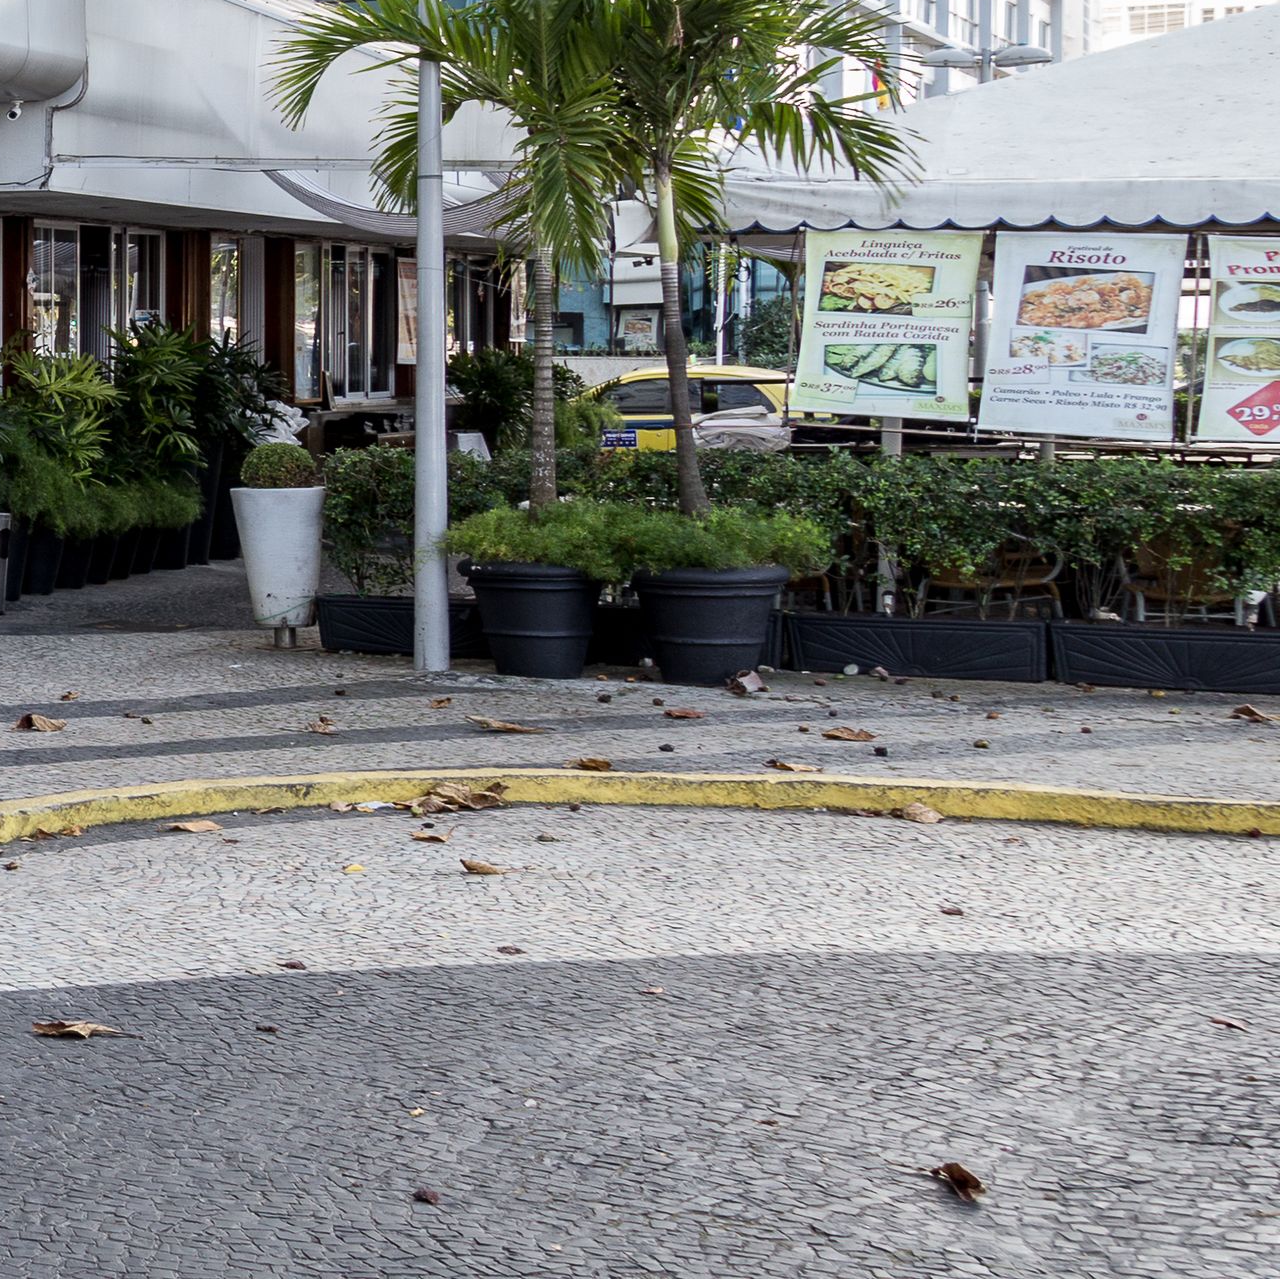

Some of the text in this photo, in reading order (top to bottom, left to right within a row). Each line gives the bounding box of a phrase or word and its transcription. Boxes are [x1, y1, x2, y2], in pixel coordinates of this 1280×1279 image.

[861, 240, 923, 250] Linguiça
[824, 249, 962, 260] Acebolada c/ Fritas
[1048, 250, 1127, 265] Risoto
[813, 320, 960, 334] Sardinha Portuguesa
[854, 330, 899, 339] Batata
[903, 331, 950, 342] Cozida
[989, 395, 1021, 403] Carne
[1055, 398, 1089, 406] Risoto
[1091, 400, 1121, 408] Misto
[993, 387, 1162, 403] Camarão Polvo Lula Frango
